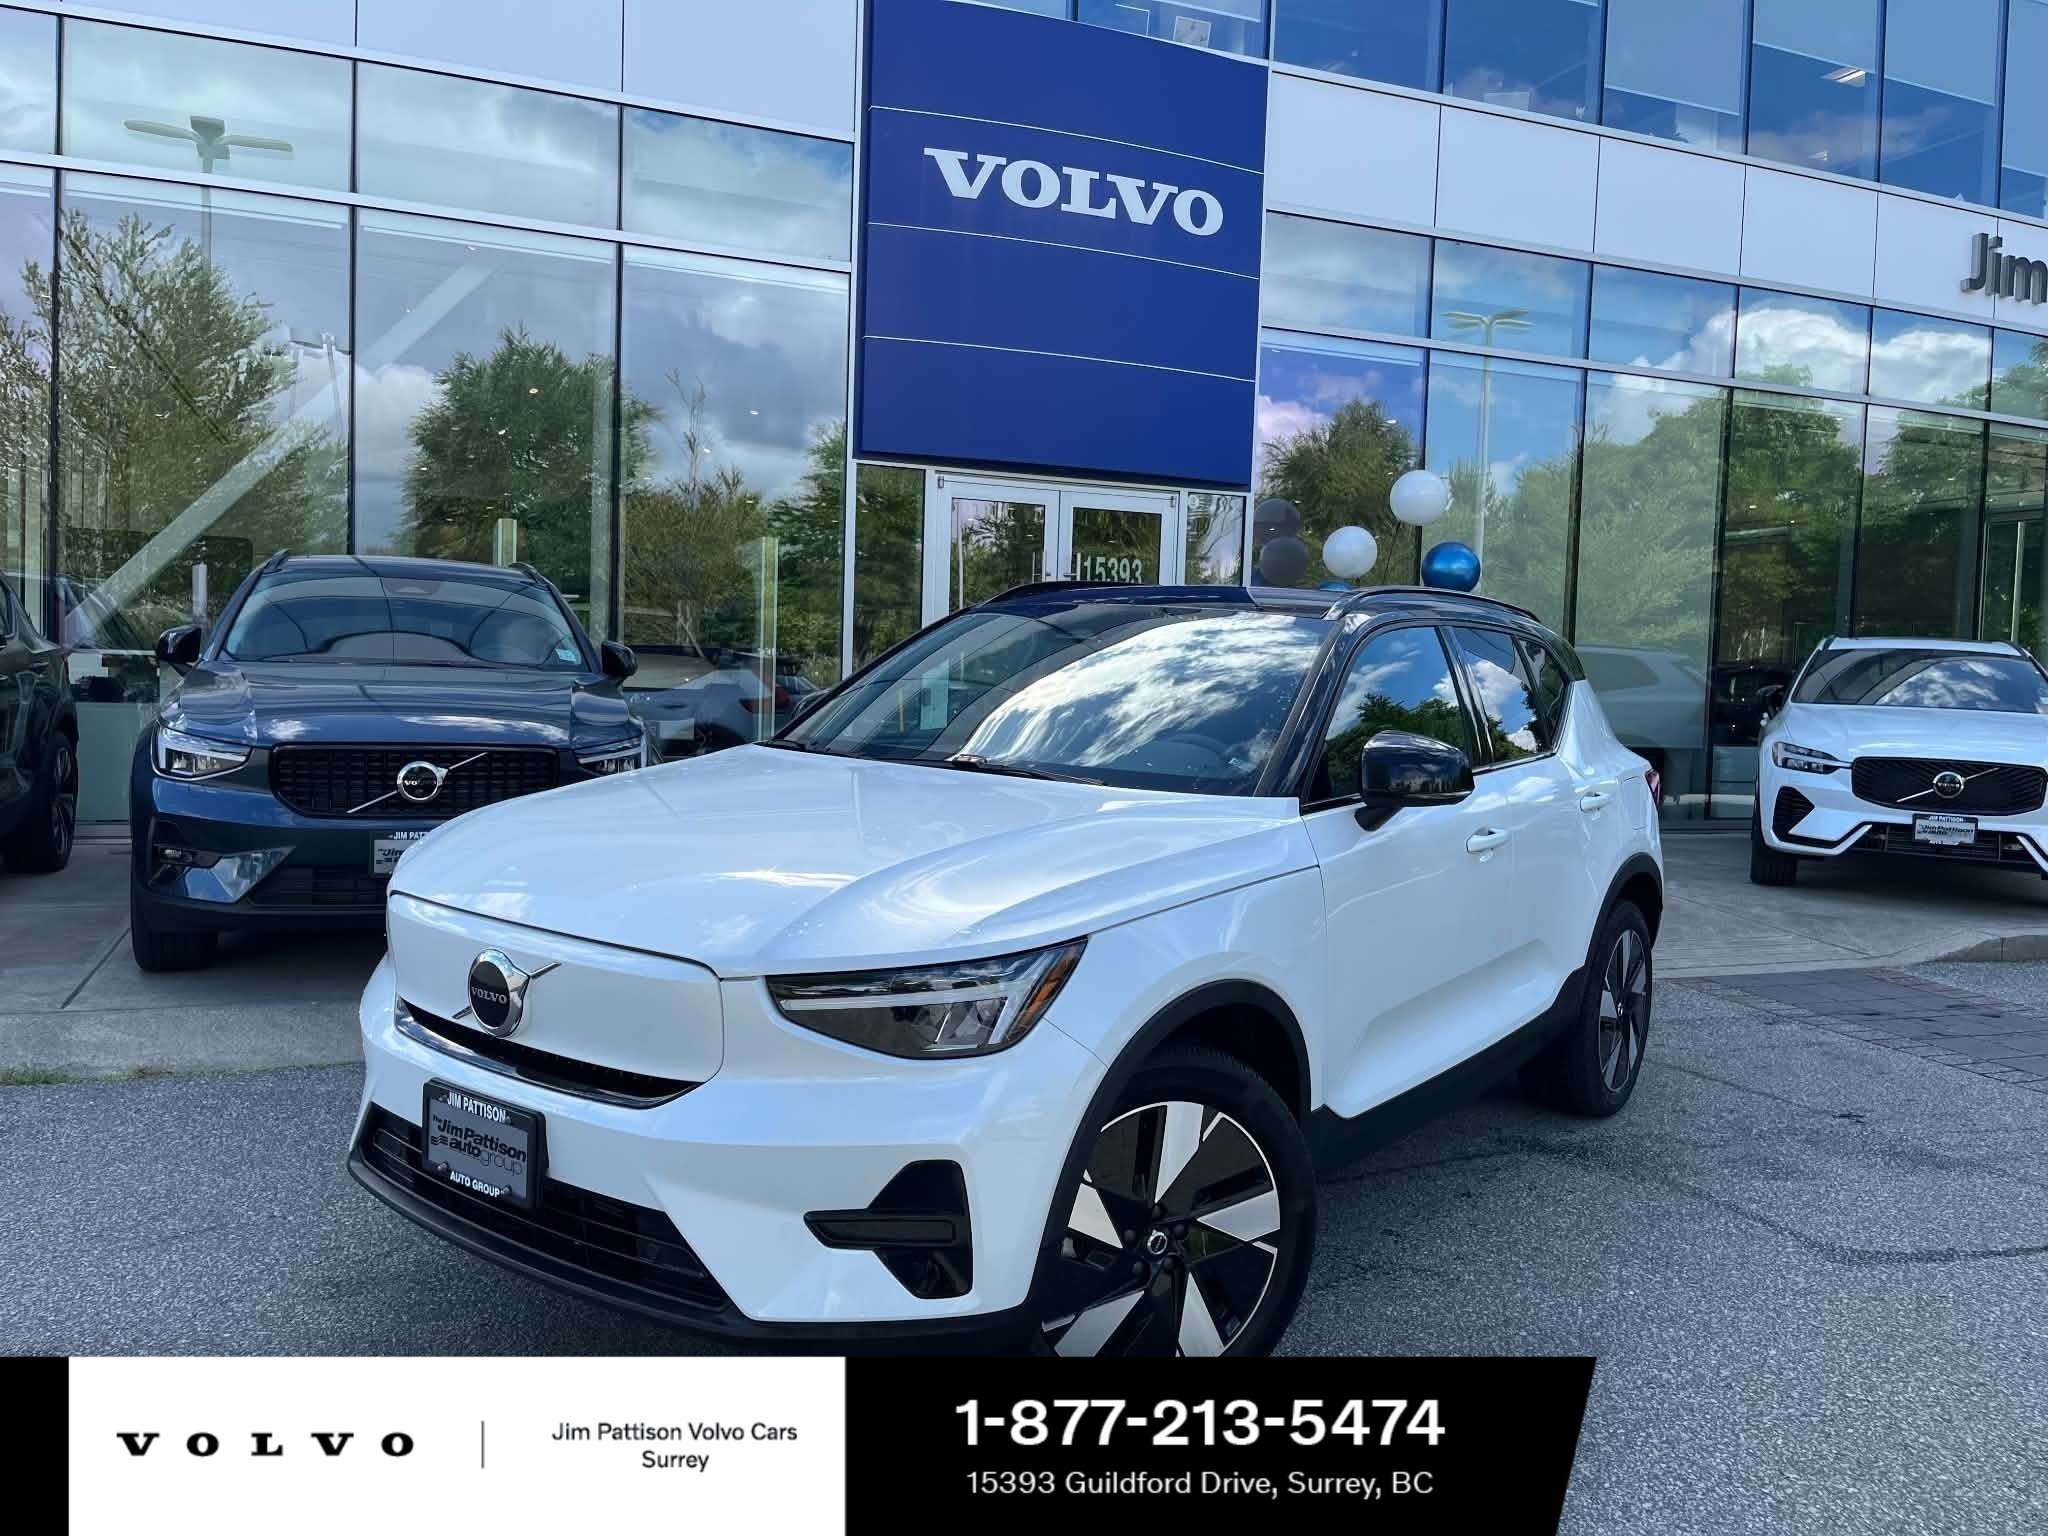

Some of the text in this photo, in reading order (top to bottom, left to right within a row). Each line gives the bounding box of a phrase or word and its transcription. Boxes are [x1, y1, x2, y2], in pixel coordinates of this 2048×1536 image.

[923, 147, 1224, 237] VOLVO
[1960, 232, 2048, 305] Jim
[1083, 555, 1143, 584] 15393
[394, 831, 408, 840] JIM
[471, 986, 507, 1005] VOLVO
[447, 1090, 507, 1123] JIM PATTISON
[450, 1170, 500, 1198] AUTO GROUP
